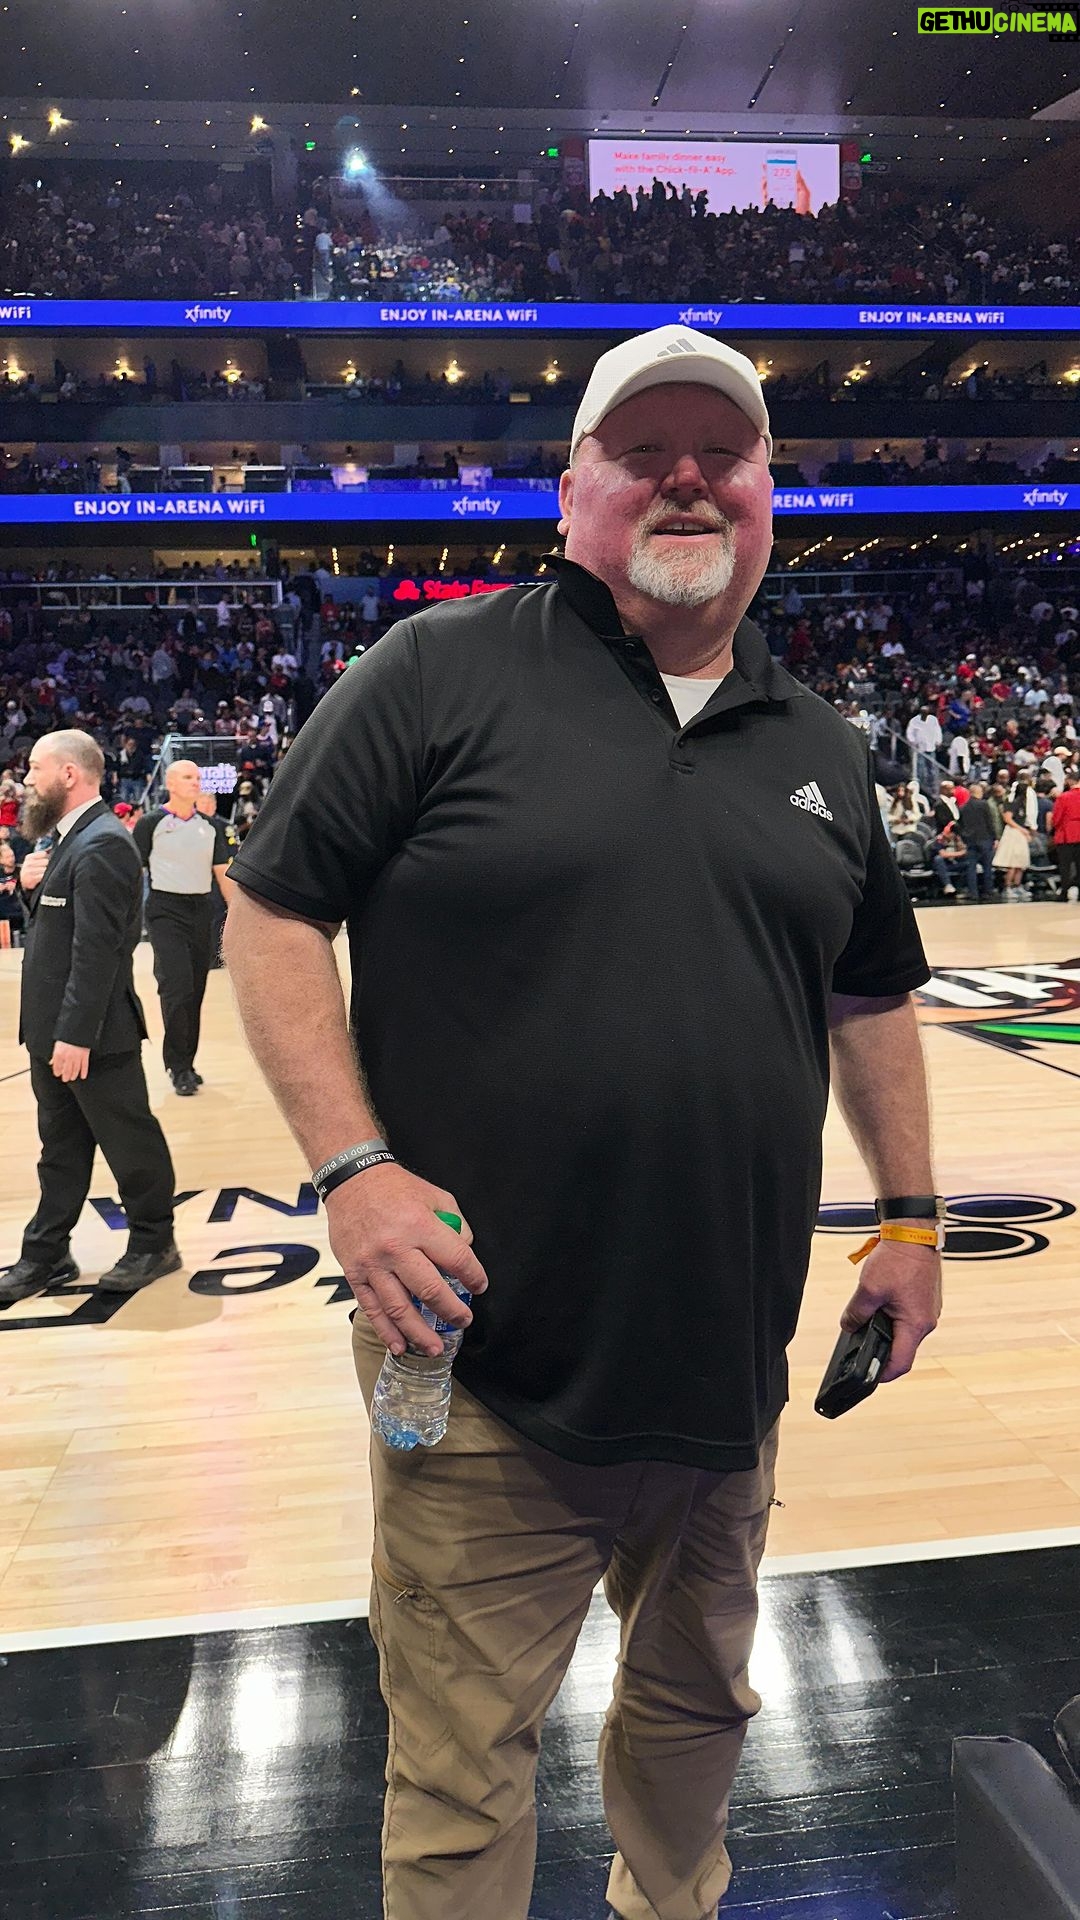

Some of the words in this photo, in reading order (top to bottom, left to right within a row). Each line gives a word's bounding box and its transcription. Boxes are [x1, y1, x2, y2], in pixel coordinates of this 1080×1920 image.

[614, 152, 638, 160] Make
[642, 152, 669, 162] family
[672, 153, 702, 161] dinner
[705, 154, 726, 163] easy
[615, 165, 635, 173] with
[638, 165, 653, 173] the
[0, 306, 31, 319] WiFi
[185, 305, 232, 323] xfinity
[380, 309, 427, 321] ENJOY
[431, 309, 503, 321] IN-ARENA
[506, 309, 537, 321] WiFi
[679, 308, 722, 325] xfinity
[859, 311, 903, 323] ENJOY
[906, 311, 972, 324] IN-ARENA
[975, 312, 1005, 324] WiFi
[772, 494, 816, 508] RENA
[819, 493, 854, 507] WiFi
[1022, 488, 1068, 506] xfinity
[74, 500, 132, 515] ENJOY
[136, 500, 223, 514] IN-ARENA
[227, 499, 265, 514] WiFi
[452, 496, 501, 515] xfinity
[423, 580, 470, 599] State
[789, 794, 833, 821] adidas
[350, 1143, 369, 1157] GOD
[338, 1153, 349, 1164] IS
